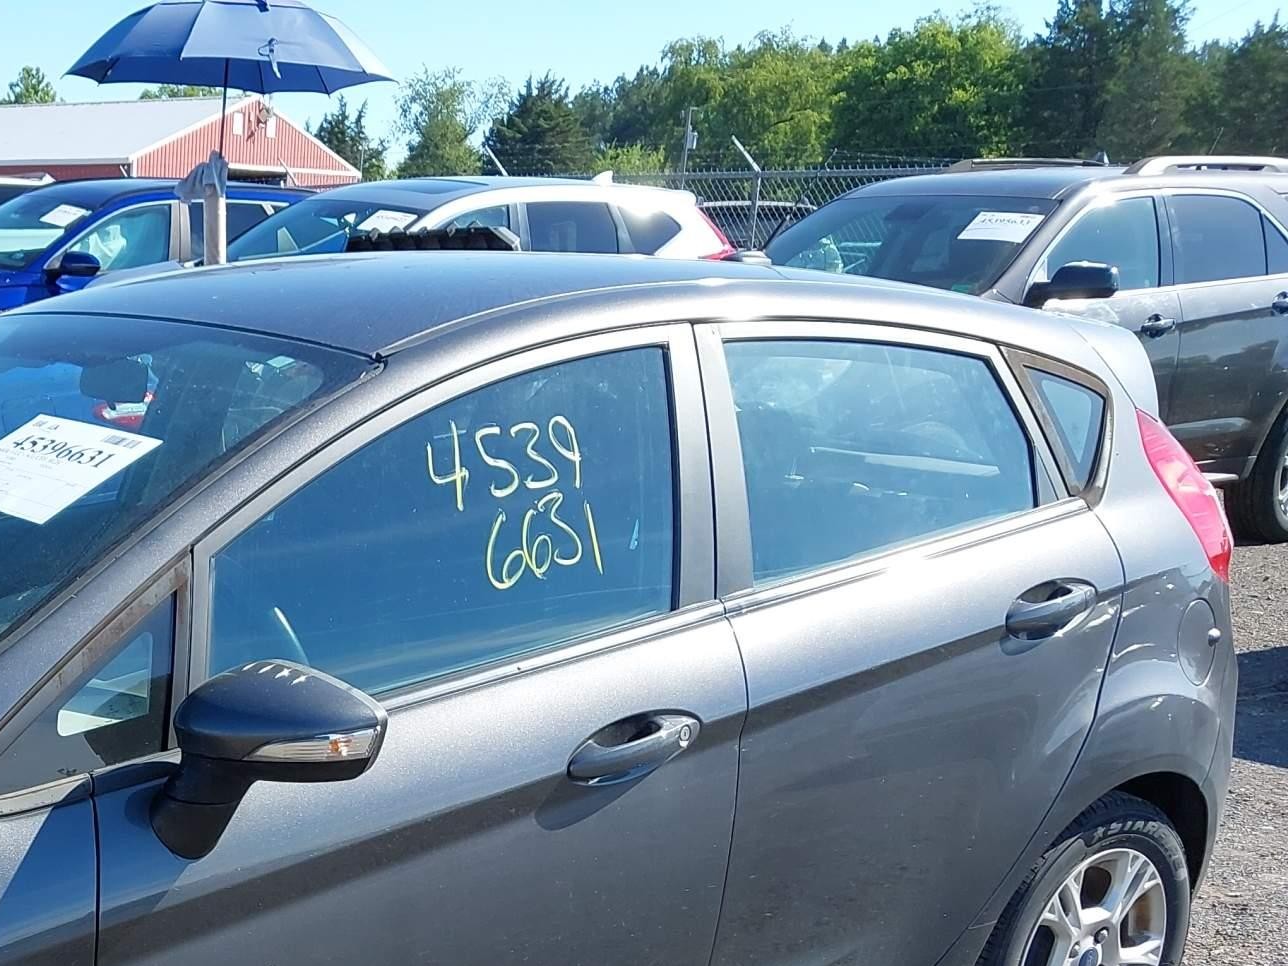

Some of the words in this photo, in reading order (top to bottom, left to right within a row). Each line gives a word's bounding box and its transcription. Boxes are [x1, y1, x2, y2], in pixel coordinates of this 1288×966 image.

[12, 434, 117, 468] 45396631
[425, 415, 581, 511] 4539
[485, 489, 604, 590] 6631
